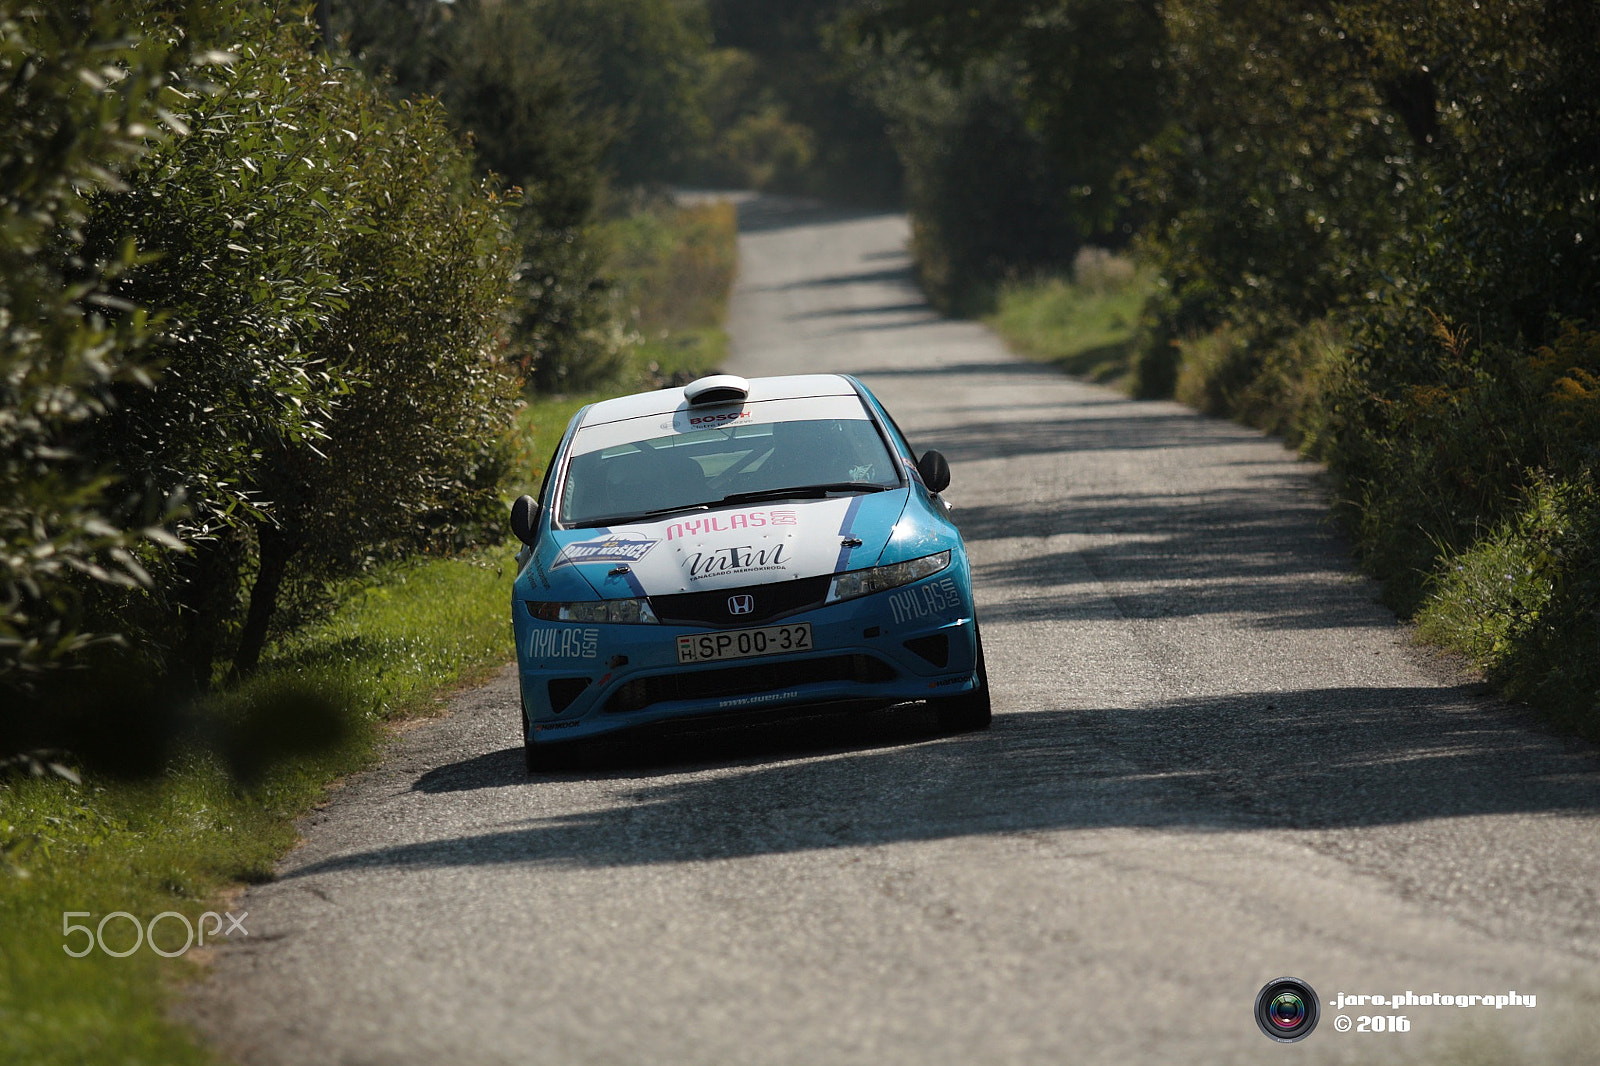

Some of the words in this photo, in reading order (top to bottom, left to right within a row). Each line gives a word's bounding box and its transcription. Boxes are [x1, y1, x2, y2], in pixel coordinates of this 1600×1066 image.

[690, 411, 752, 425] BOSCH
[666, 512, 767, 540] NYILAS
[561, 545, 600, 562] RALLY
[888, 582, 946, 625] NYILAS
[529, 628, 582, 658] NYILAS
[582, 628, 600, 658] GSM
[699, 634, 732, 658] SP
[737, 626, 809, 654] 00-32
